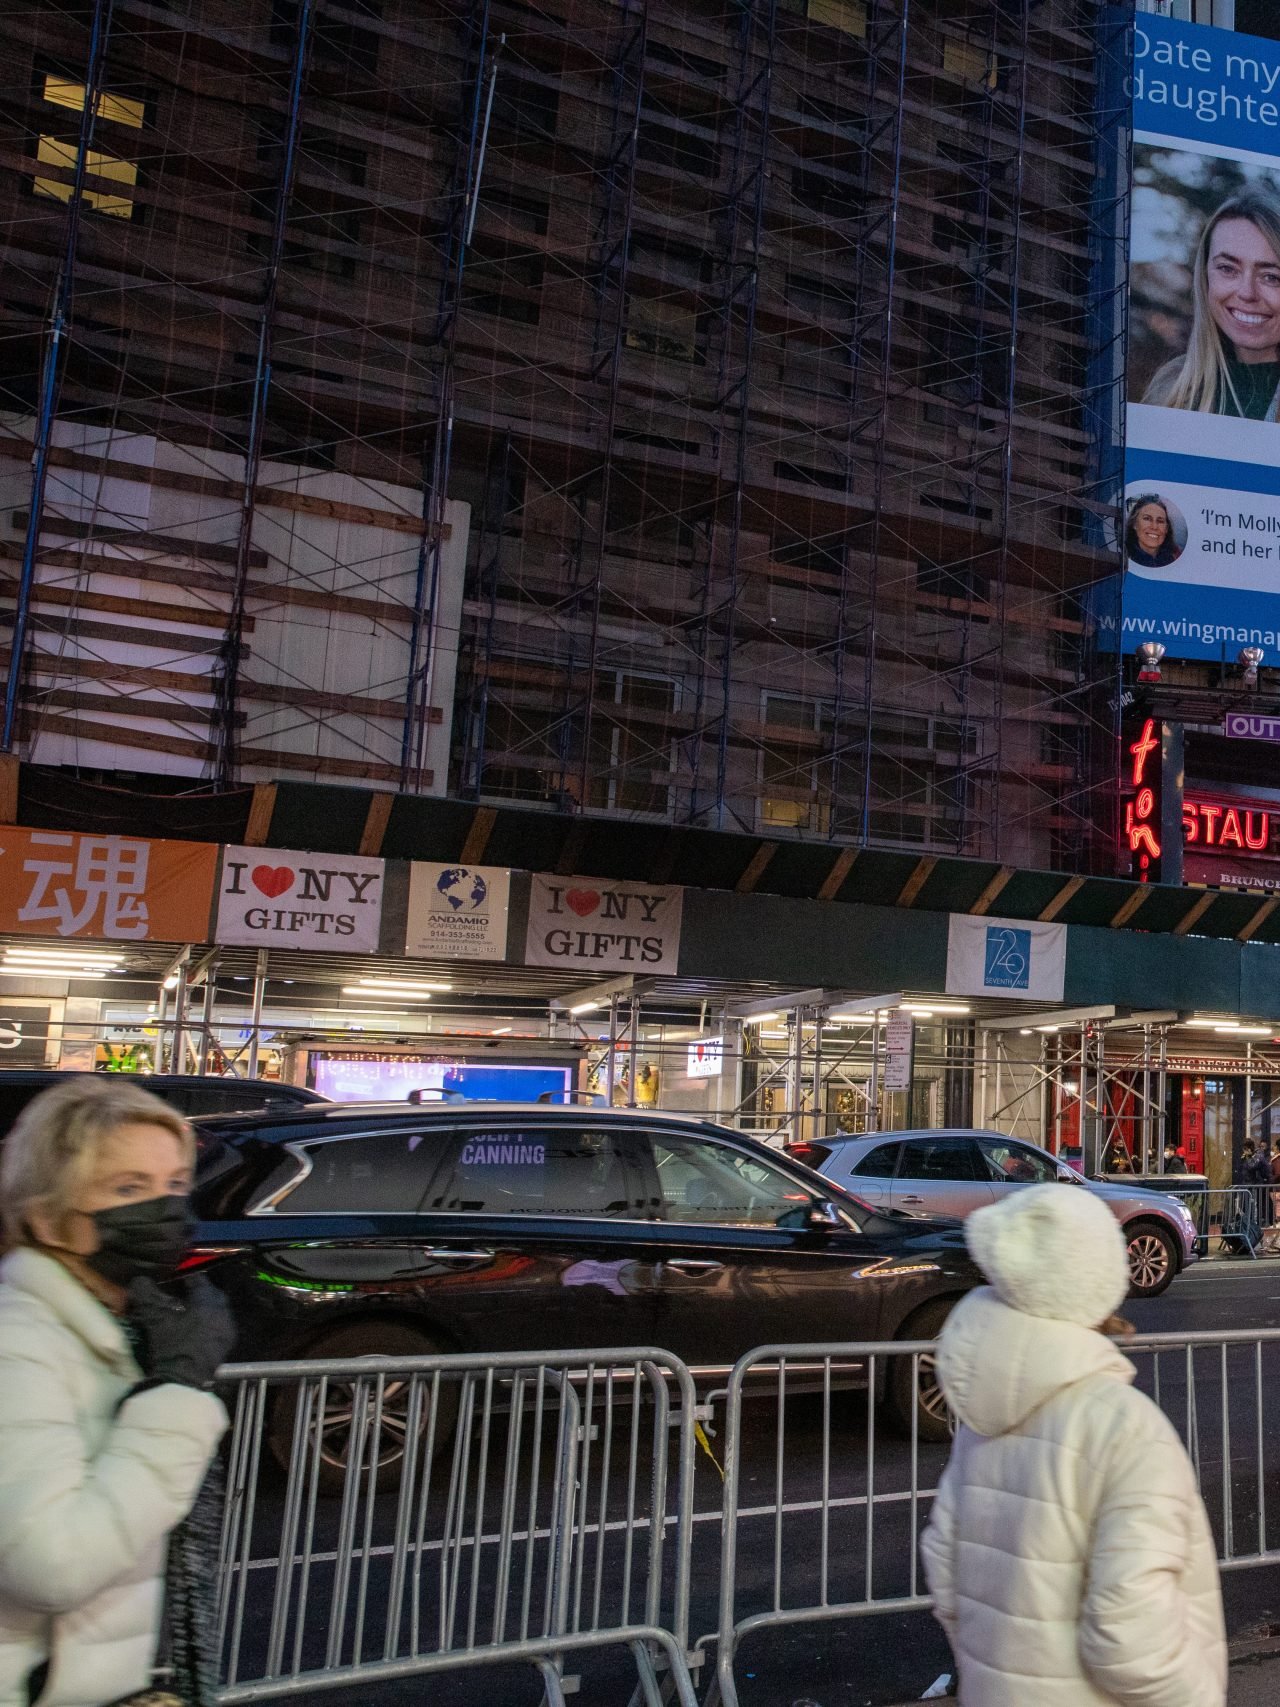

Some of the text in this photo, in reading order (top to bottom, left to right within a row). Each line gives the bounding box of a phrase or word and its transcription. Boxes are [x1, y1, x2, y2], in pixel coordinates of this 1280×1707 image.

[1124, 27, 1212, 73] Date
[1200, 537, 1237, 556] and
[1242, 542, 1273, 560] her
[18, 833, 151, 940] 魂
[225, 862, 380, 904] I NY
[546, 886, 667, 923] I NY
[244, 908, 356, 936] GIFTS
[428, 915, 489, 926] ANDAMIO
[544, 929, 663, 963] GIFTS
[985, 977, 1013, 985] SEVENTH
[458, 1144, 545, 1165] CANNING
